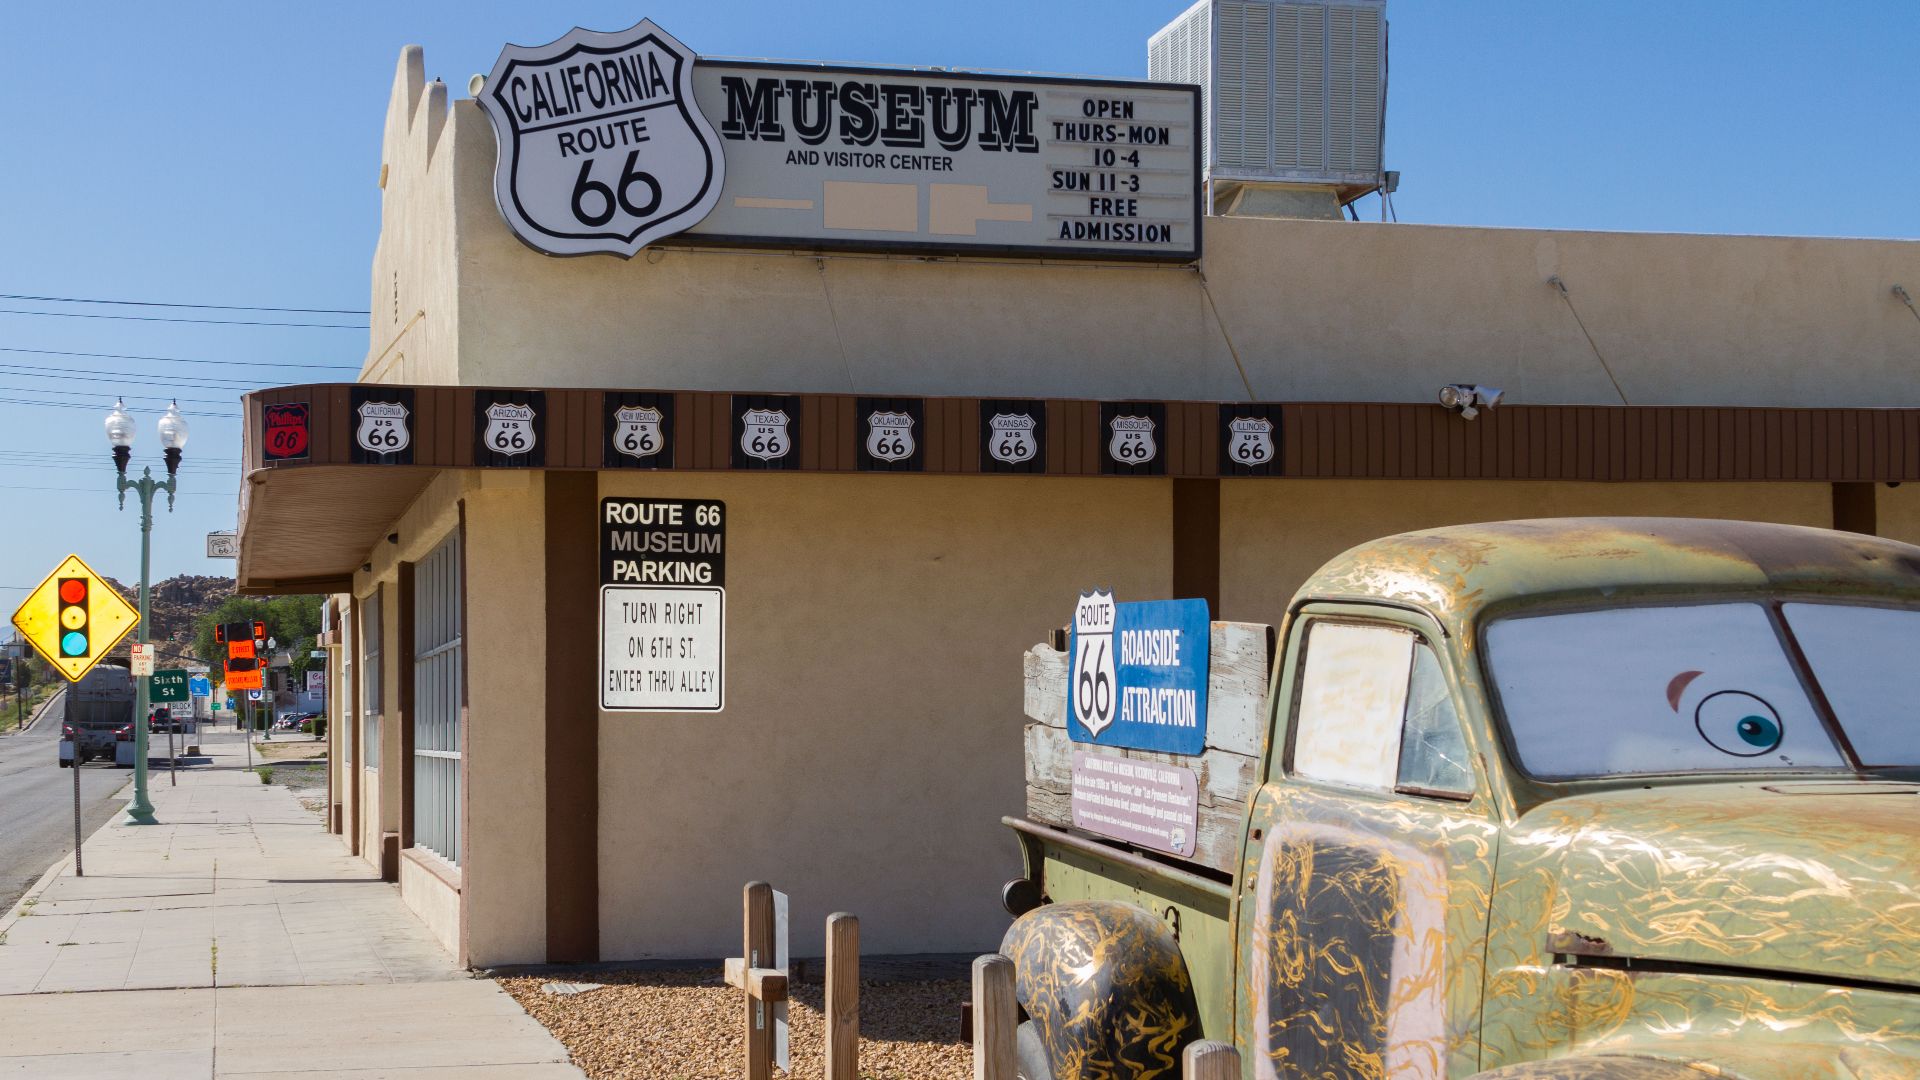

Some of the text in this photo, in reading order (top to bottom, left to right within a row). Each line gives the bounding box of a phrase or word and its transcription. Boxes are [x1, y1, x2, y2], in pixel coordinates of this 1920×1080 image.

[511, 51, 671, 123] CALIFORNIA
[721, 76, 1040, 153] MUSEUM
[1083, 99, 1134, 119] OPEN
[557, 117, 650, 158] ROUTE
[1052, 122, 1169, 145] THURS-MON
[786, 150, 953, 171] AND VISITOR CENTER
[571, 150, 662, 227] 66
[1053, 171, 1090, 191] SUN
[1090, 198, 1137, 217] FREE
[1060, 221, 1171, 242] ADMISSION
[269, 411, 304, 426] Phillips
[367, 406, 402, 416] CALIFORNIA
[493, 409, 528, 418] ARIZONA
[621, 412, 656, 421] NEW MEXICO
[754, 415, 780, 424] TEXAS
[873, 416, 909, 426] OKLAHOMA
[997, 419, 1028, 428] KANSAS
[1116, 421, 1150, 430] MISSOURI
[1236, 422, 1266, 431] ILLINOIS
[274, 431, 299, 449] 66
[368, 428, 399, 447] 66
[495, 431, 525, 449] 66
[624, 433, 654, 451] 66
[752, 436, 780, 453] 66
[877, 438, 905, 455] 66
[1000, 440, 1027, 457] 66
[1119, 442, 1147, 458] 66
[1238, 443, 1264, 459] 66
[606, 502, 720, 526] ROUTE 66
[611, 531, 721, 553] MUSEUM
[613, 560, 712, 583] PARKING
[623, 602, 703, 624] TURN RIGHT
[1080, 603, 1110, 626] ROUTE
[133, 645, 142, 653] NO
[628, 636, 696, 658] ON 6TH ST.
[1121, 629, 1181, 666] ROADSIDE
[154, 676, 183, 685] Sixth
[609, 670, 714, 692] ENTER THRU ALLEY
[1079, 639, 1110, 721] 66
[162, 687, 175, 696] St
[1121, 686, 1196, 727] ATTRACTION
